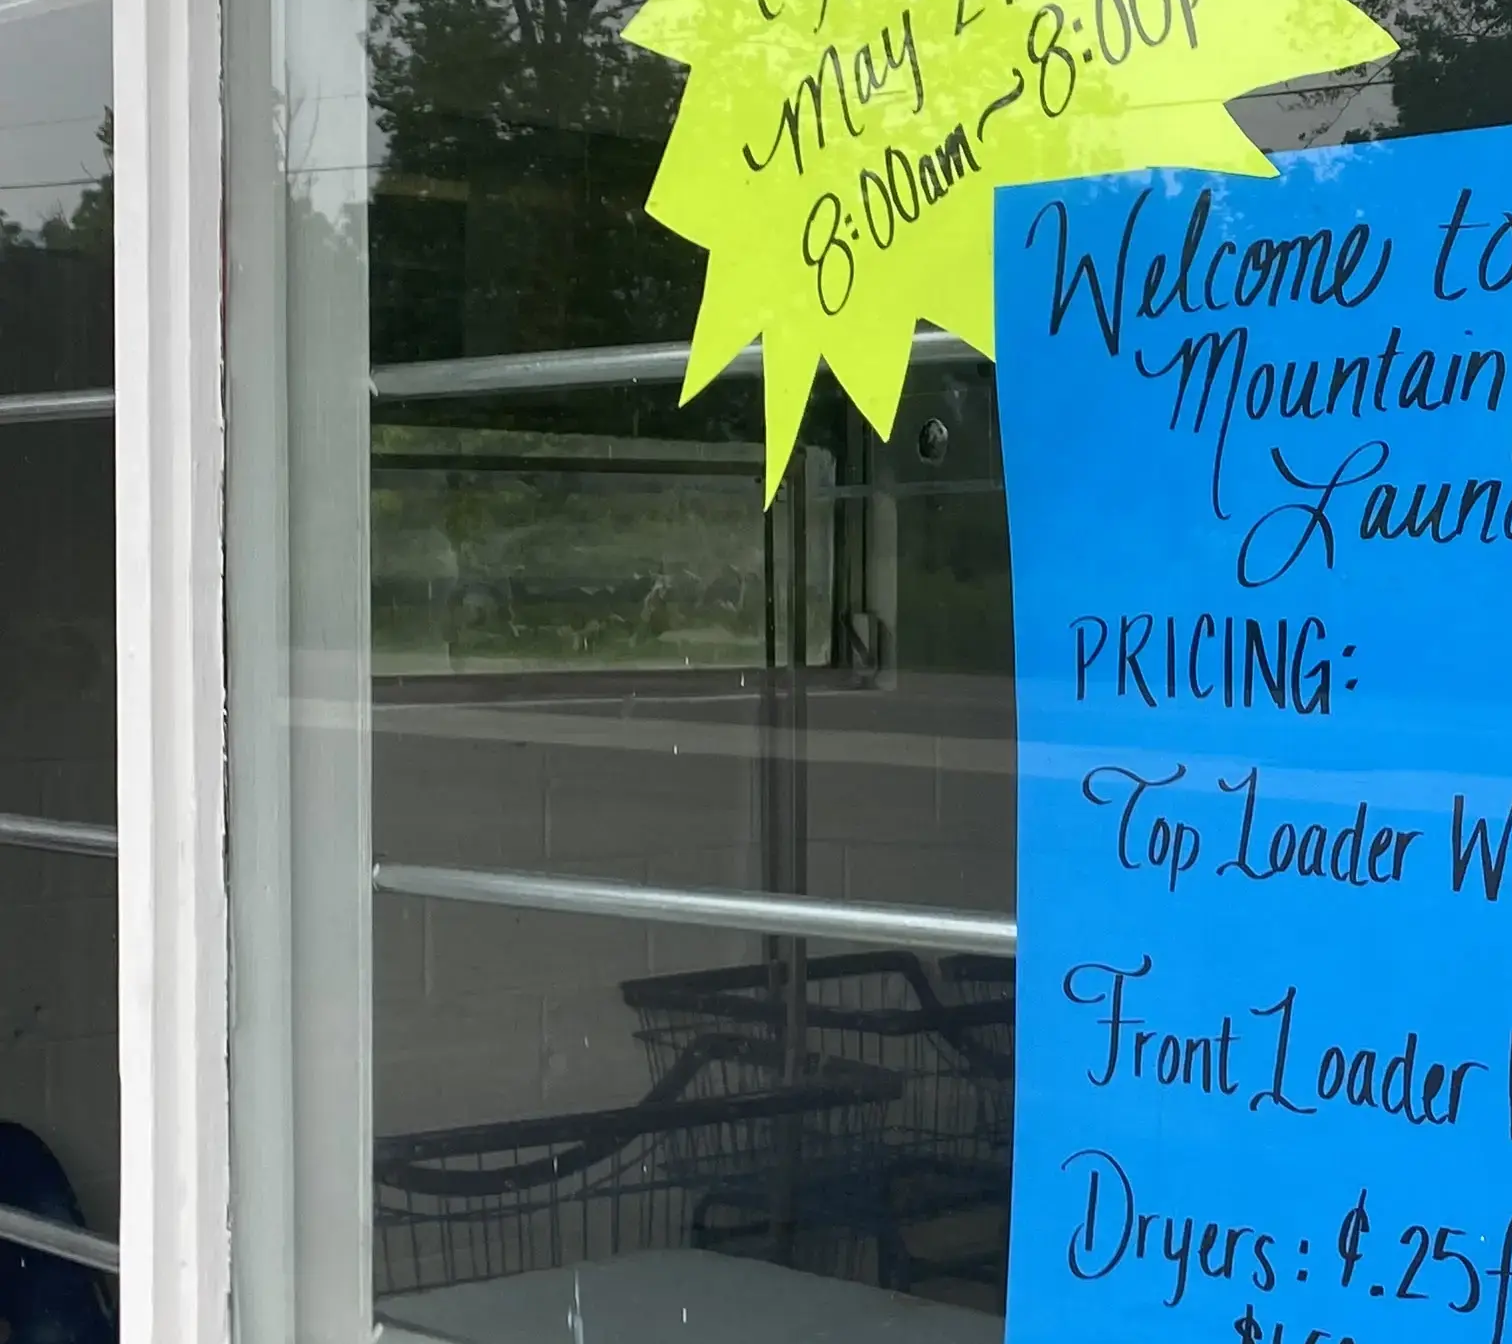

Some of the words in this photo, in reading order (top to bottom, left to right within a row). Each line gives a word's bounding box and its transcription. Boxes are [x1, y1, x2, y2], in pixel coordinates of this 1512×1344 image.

[743, 9, 926, 176] May
[1025, 188, 1391, 358] Welcome
[1136, 325, 1506, 521] Mountain
[1070, 612, 1359, 715] PRICING:
[1082, 762, 1202, 893] Top
[1215, 765, 1424, 889] Loader
[1063, 954, 1239, 1087] Front
[1249, 985, 1490, 1129] Loader
[1061, 1148, 1310, 1307] Dryers:
